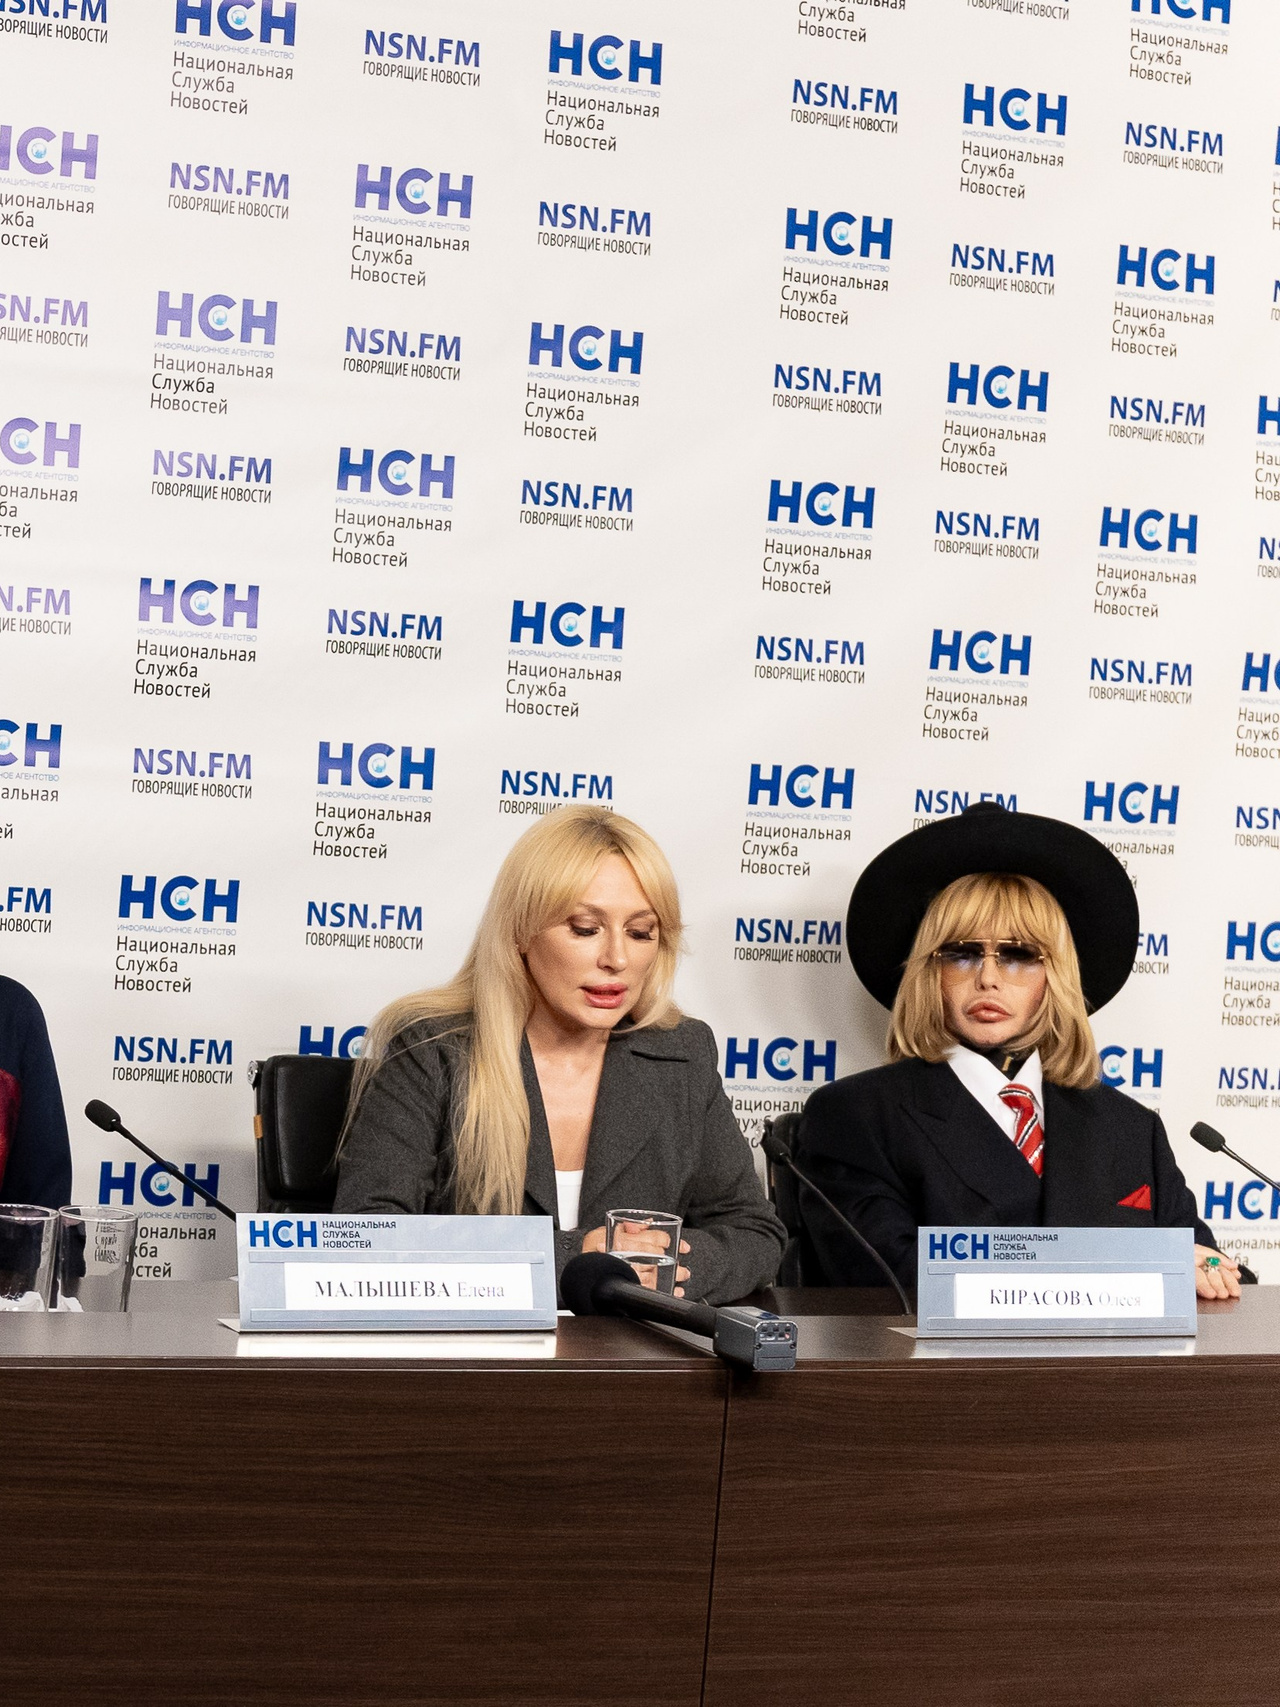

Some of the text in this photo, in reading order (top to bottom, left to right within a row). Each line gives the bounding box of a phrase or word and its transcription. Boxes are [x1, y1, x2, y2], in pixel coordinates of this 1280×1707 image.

[365, 30, 479, 67] NSN.FM
[549, 30, 663, 85] НСН
[363, 61, 480, 87] ГОВОРЯЩИЕ НОВОСТИ
[547, 90, 659, 117] Национальная
[793, 79, 897, 115] NSN.FM
[546, 109, 604, 130] Служба
[963, 83, 1067, 136] НСН
[791, 109, 897, 133] ГОВОРЯЩИЕ НОВОСТИ
[544, 129, 616, 151] Новостей
[963, 141, 1064, 167] Национальная
[961, 159, 1014, 179] Служба
[355, 164, 473, 219] НСН
[960, 177, 1025, 199] Новостей
[539, 201, 650, 237] NSN.FM
[353, 226, 469, 251] Национальная
[538, 232, 651, 256] ГОВОРЯЩИЕ НОВОСТИ
[785, 207, 893, 260] НСН
[352, 245, 412, 266] Служба
[351, 264, 425, 286] Новостей
[783, 267, 888, 291] Национальная
[781, 285, 836, 306] Служба
[780, 304, 848, 325] Новостей
[346, 327, 460, 361] NSN.FM
[344, 358, 460, 380] ГОВОРЯЩИЕ НОВОСТИ
[947, 362, 1049, 412] НСН
[944, 420, 1046, 443] Национальная
[942, 438, 995, 458] Служба
[941, 457, 1007, 476] Новостей
[522, 480, 632, 512] NSN.FM
[520, 510, 633, 531] ГОВОРЯЩИЕ НОВОСТИ
[139, 577, 259, 629] НСН
[328, 609, 442, 641] NSN.FM
[510, 600, 625, 649] НСН
[137, 639, 256, 662] Национальная
[326, 640, 441, 660] ГОВОРЯЩИЕ НОВОСТИ
[756, 635, 864, 665] NSN.FM
[929, 629, 1032, 676] НСН
[136, 659, 197, 680] Служба
[508, 660, 621, 682] Национальная
[755, 665, 864, 683] ГОВОРЯЩИЕ НОВОСТИ
[1090, 658, 1192, 686] NSN.FM
[134, 678, 210, 698] Новостей
[507, 679, 566, 699] Служба
[926, 686, 1027, 706] Национальная
[1089, 686, 1192, 704] ГОВОРЯЩИЕ НОВОСТИ
[506, 698, 578, 717] Новостей
[924, 704, 977, 724] Служба
[923, 723, 988, 740] Новостей
[134, 748, 251, 779] NSN.FM
[317, 741, 435, 790] НСН
[132, 779, 252, 799] ГОВОРЯЩИЕ НОВОСТИ
[748, 764, 855, 809] НСН
[316, 802, 431, 823] Национальная
[315, 821, 374, 841] Служба
[745, 822, 850, 840] Национальная
[313, 840, 387, 859] Новостей
[743, 840, 798, 859] Служба
[741, 859, 810, 876] Новостей
[118, 875, 240, 923] НСН
[307, 901, 422, 931] NSN.FM
[306, 932, 423, 950] ГОВОРЯЩИЕ НОВОСТИ
[736, 918, 841, 945] NSN.FM
[117, 936, 235, 955] Национальная
[734, 947, 841, 964] ГОВОРЯЩИЕ НОВОСТИ
[116, 955, 177, 975] Служба
[115, 974, 191, 992] Новостей
[114, 1036, 232, 1065] NSN.FM
[113, 1067, 232, 1084] ГОВОРЯЩИЕ НОВОСТИ
[99, 1161, 220, 1207] НСН
[249, 1220, 317, 1248] НСН
[322, 1220, 397, 1230] НАЦИОНАЛЬНАЯ
[322, 1230, 361, 1239] СЛУЖБА
[322, 1238, 372, 1249] НОВОСТЕЙ
[929, 1233, 989, 1260] НСН
[993, 1233, 1059, 1243] НАЦИОНАЛЬНАЯ
[993, 1243, 1027, 1252] СЛУЖБА
[993, 1251, 1037, 1261] НОВОСТЕЙ
[315, 1280, 505, 1299] МАЛЫШЕВА Елена
[990, 1289, 1093, 1307] КИРАСОВА
